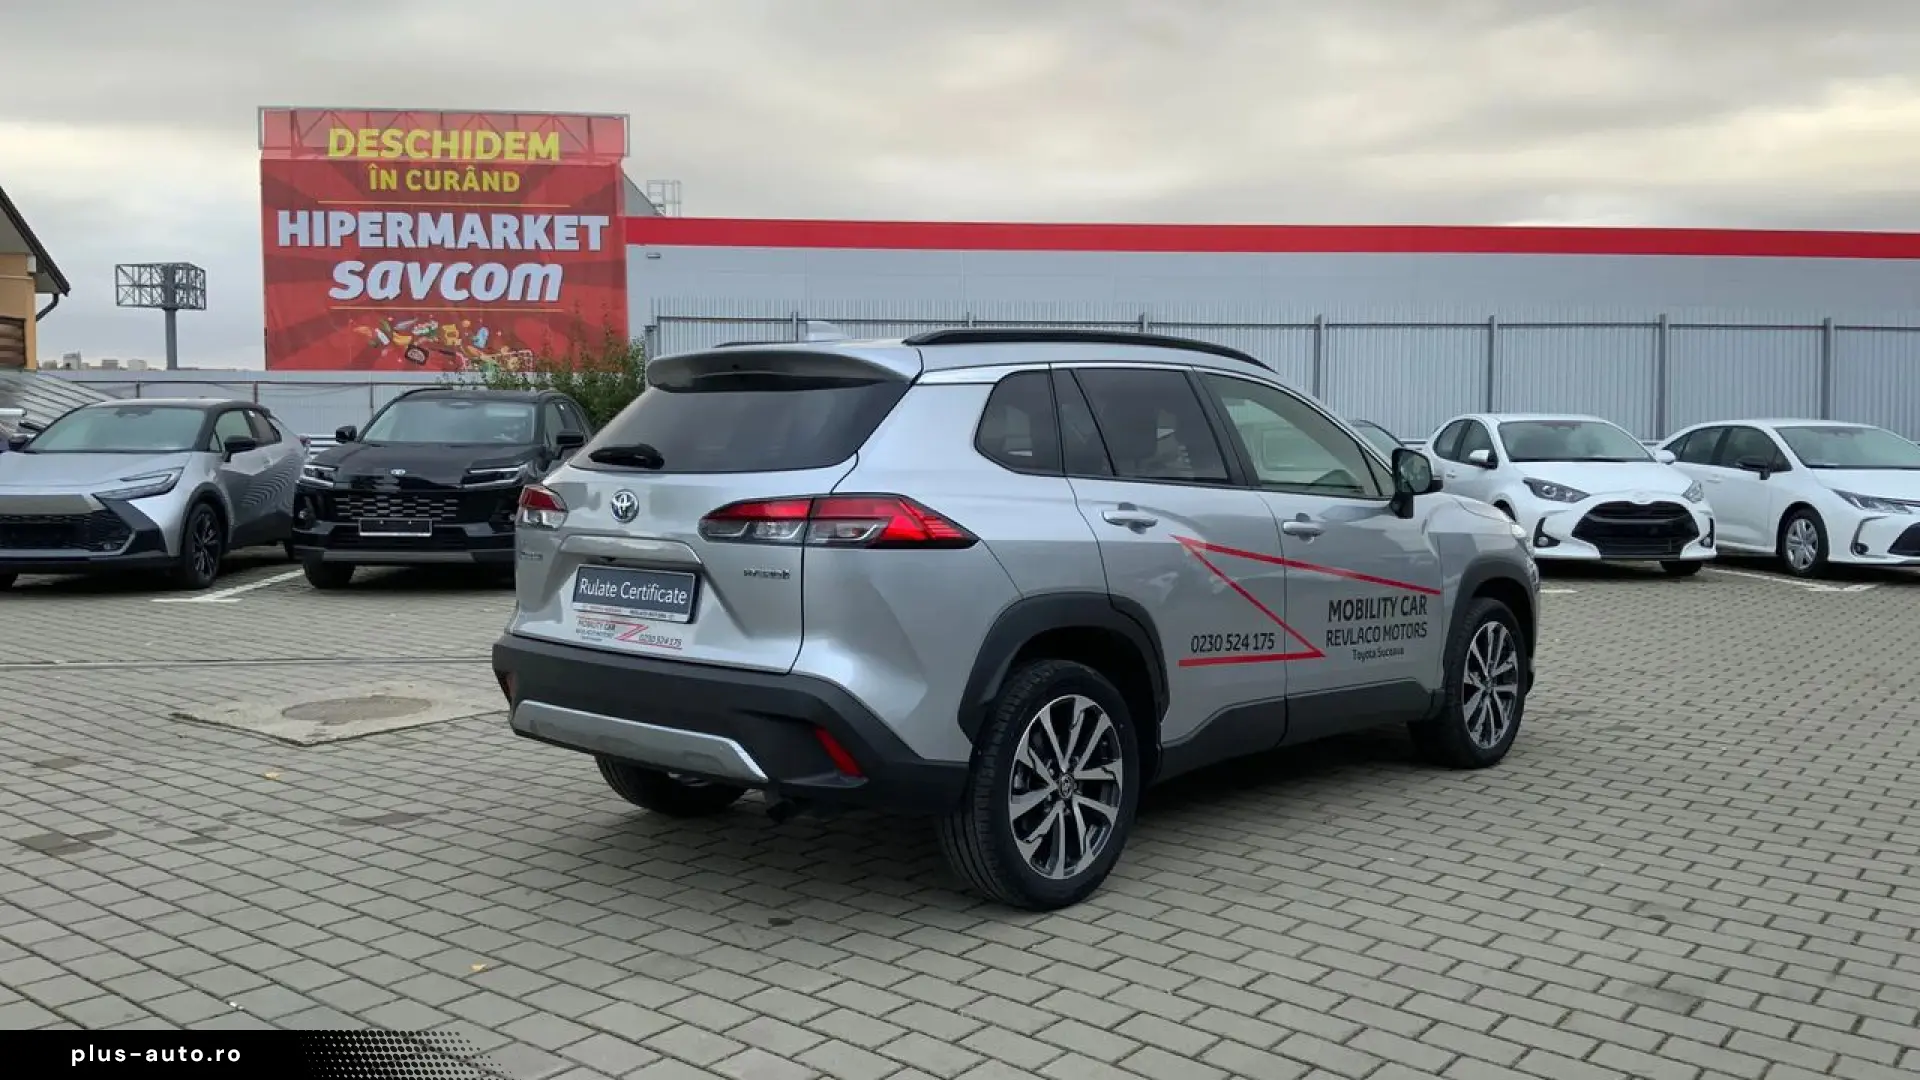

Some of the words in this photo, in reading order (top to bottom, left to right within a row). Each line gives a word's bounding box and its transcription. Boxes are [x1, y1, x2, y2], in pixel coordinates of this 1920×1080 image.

[328, 128, 560, 160] DESCHIDEM
[367, 163, 397, 191] ÎN
[405, 166, 520, 193] CURÂND
[277, 209, 609, 251] HIPERMARKET
[329, 261, 564, 302] savcom
[579, 578, 617, 598] Rulate
[620, 581, 688, 604] Certificate
[1328, 597, 1398, 622] MOBILITY
[1400, 594, 1428, 616] CAR
[1191, 634, 1223, 653] 0230
[1225, 633, 1249, 651] 524
[1253, 633, 1275, 650] 175
[1326, 626, 1381, 648] REVLACO
[1382, 622, 1428, 641] MOTORS
